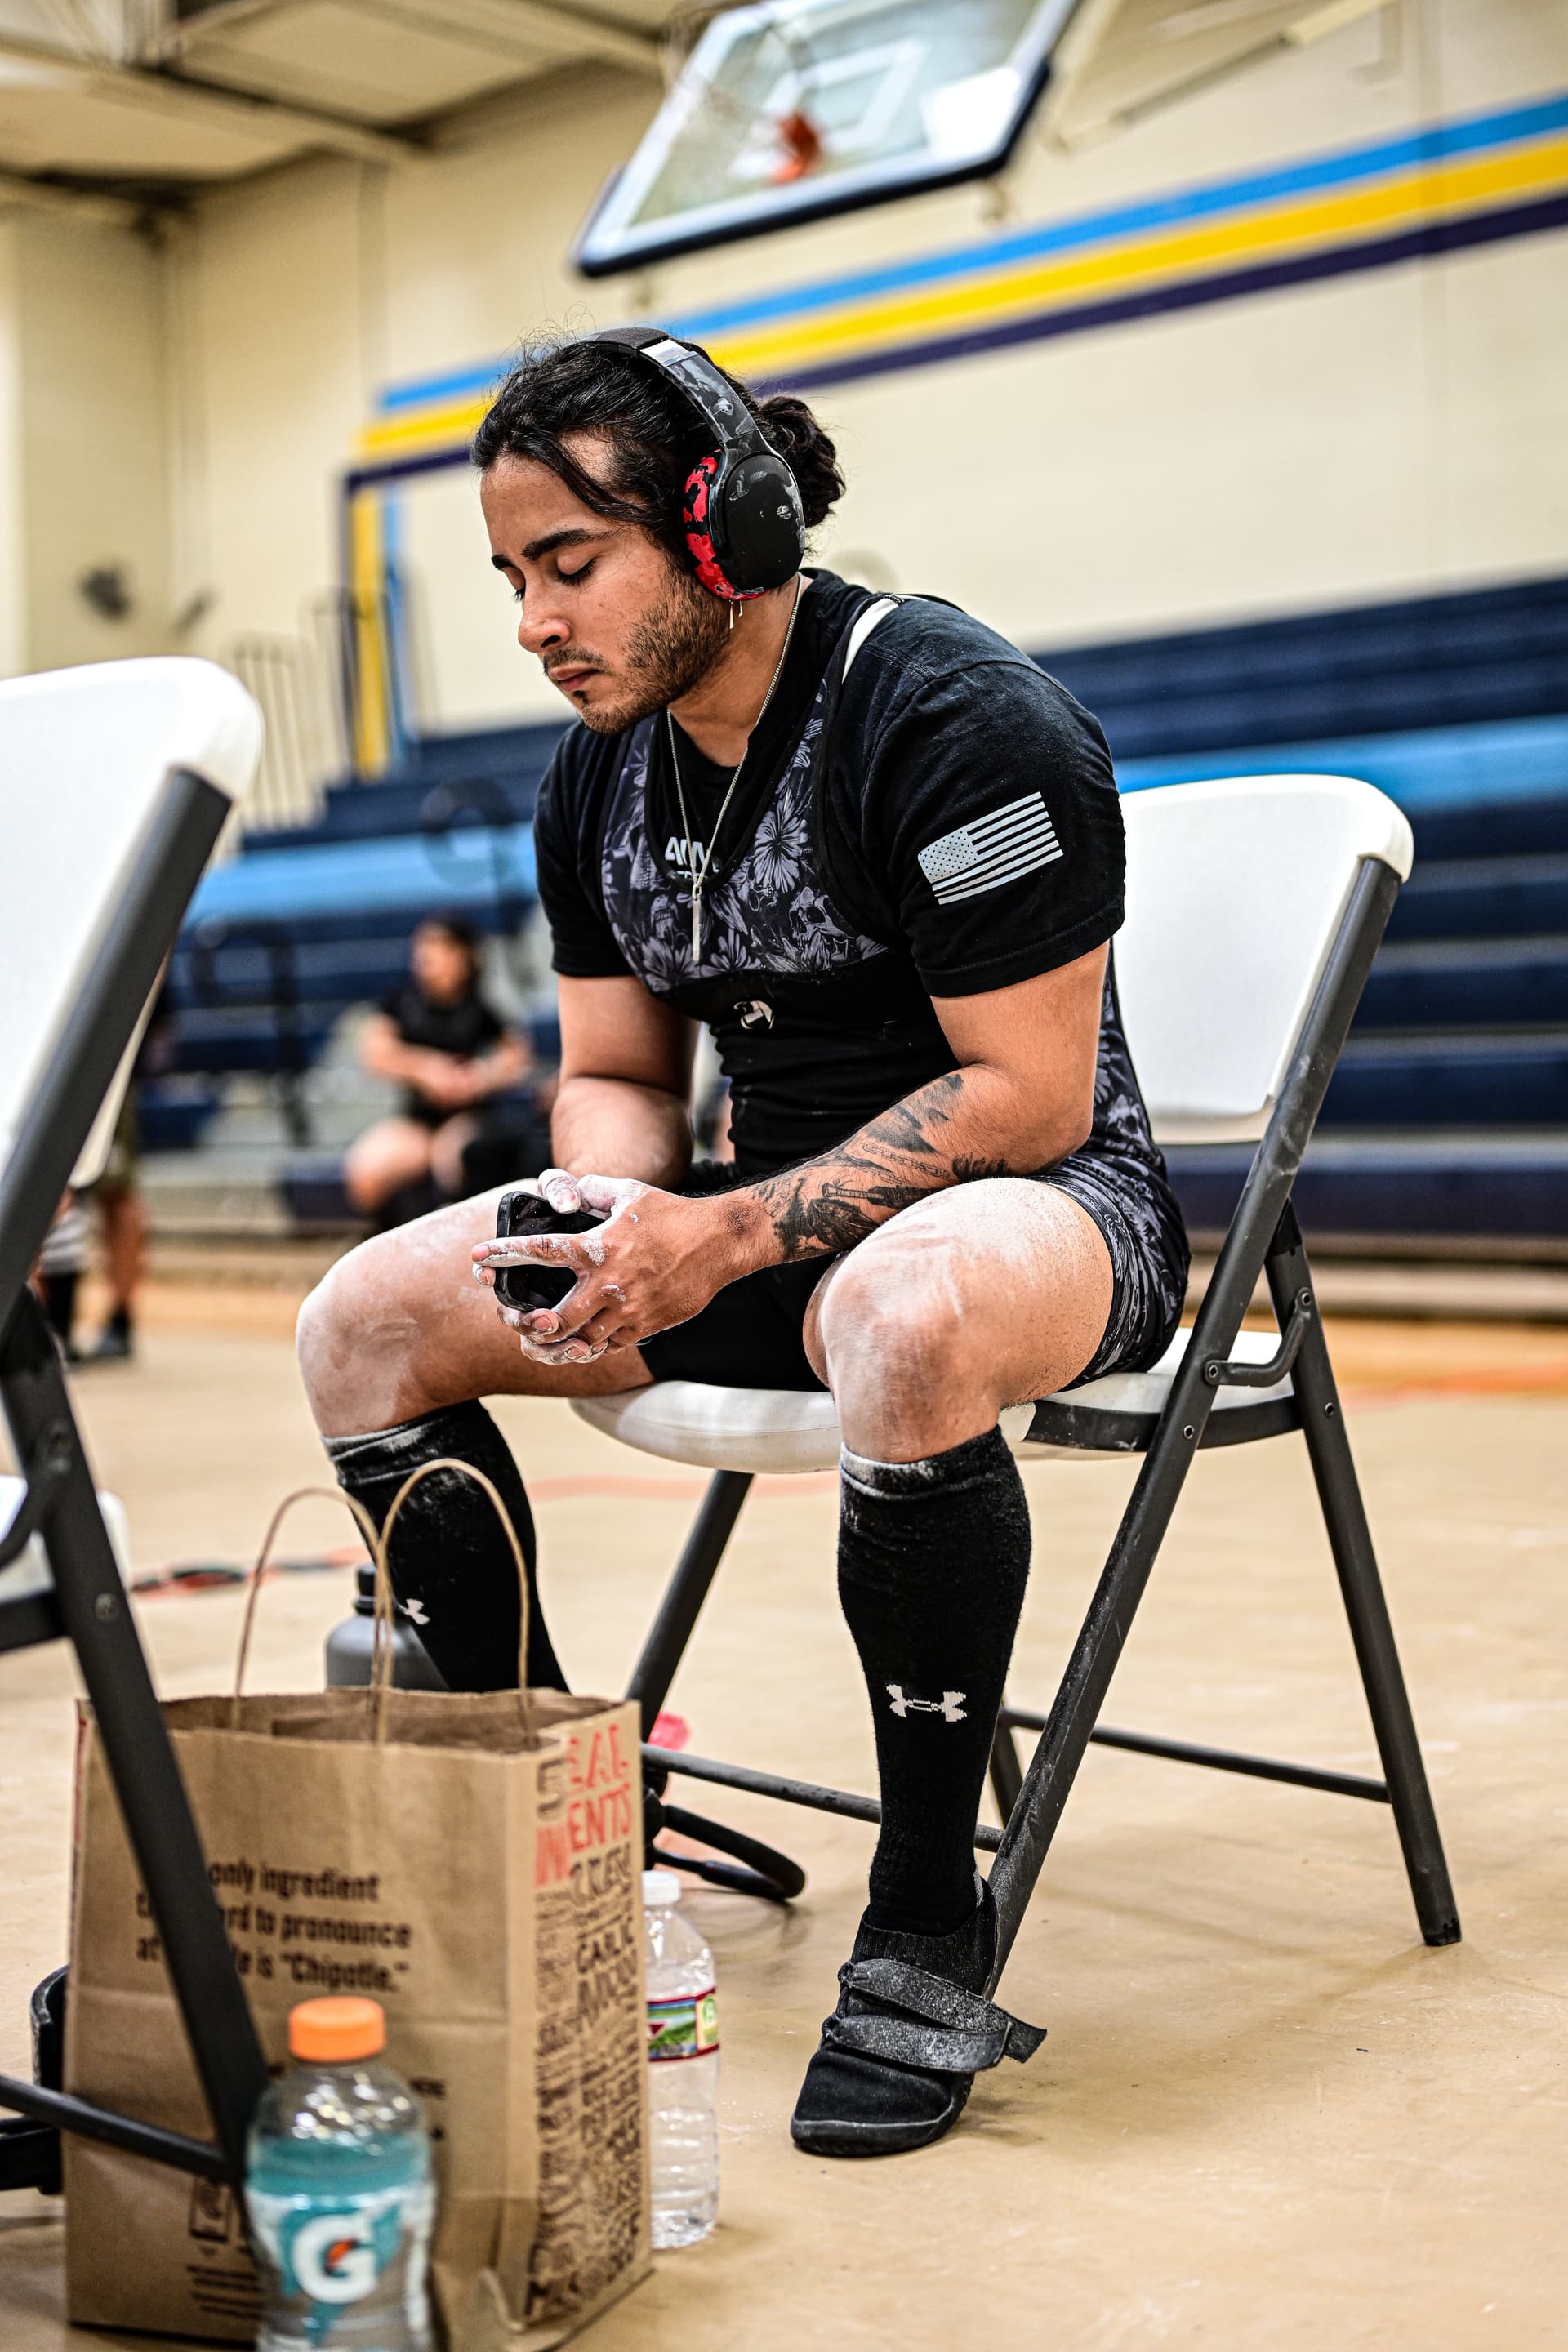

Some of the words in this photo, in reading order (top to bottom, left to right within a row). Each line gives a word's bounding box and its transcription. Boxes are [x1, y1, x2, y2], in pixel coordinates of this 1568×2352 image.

[210, 1860, 252, 1895] only
[260, 1860, 378, 1902] ingredient
[256, 1906, 276, 1936] to
[282, 1913, 412, 1949] pronounce
[256, 1947, 273, 1979] is
[292, 2214, 379, 2306] G
